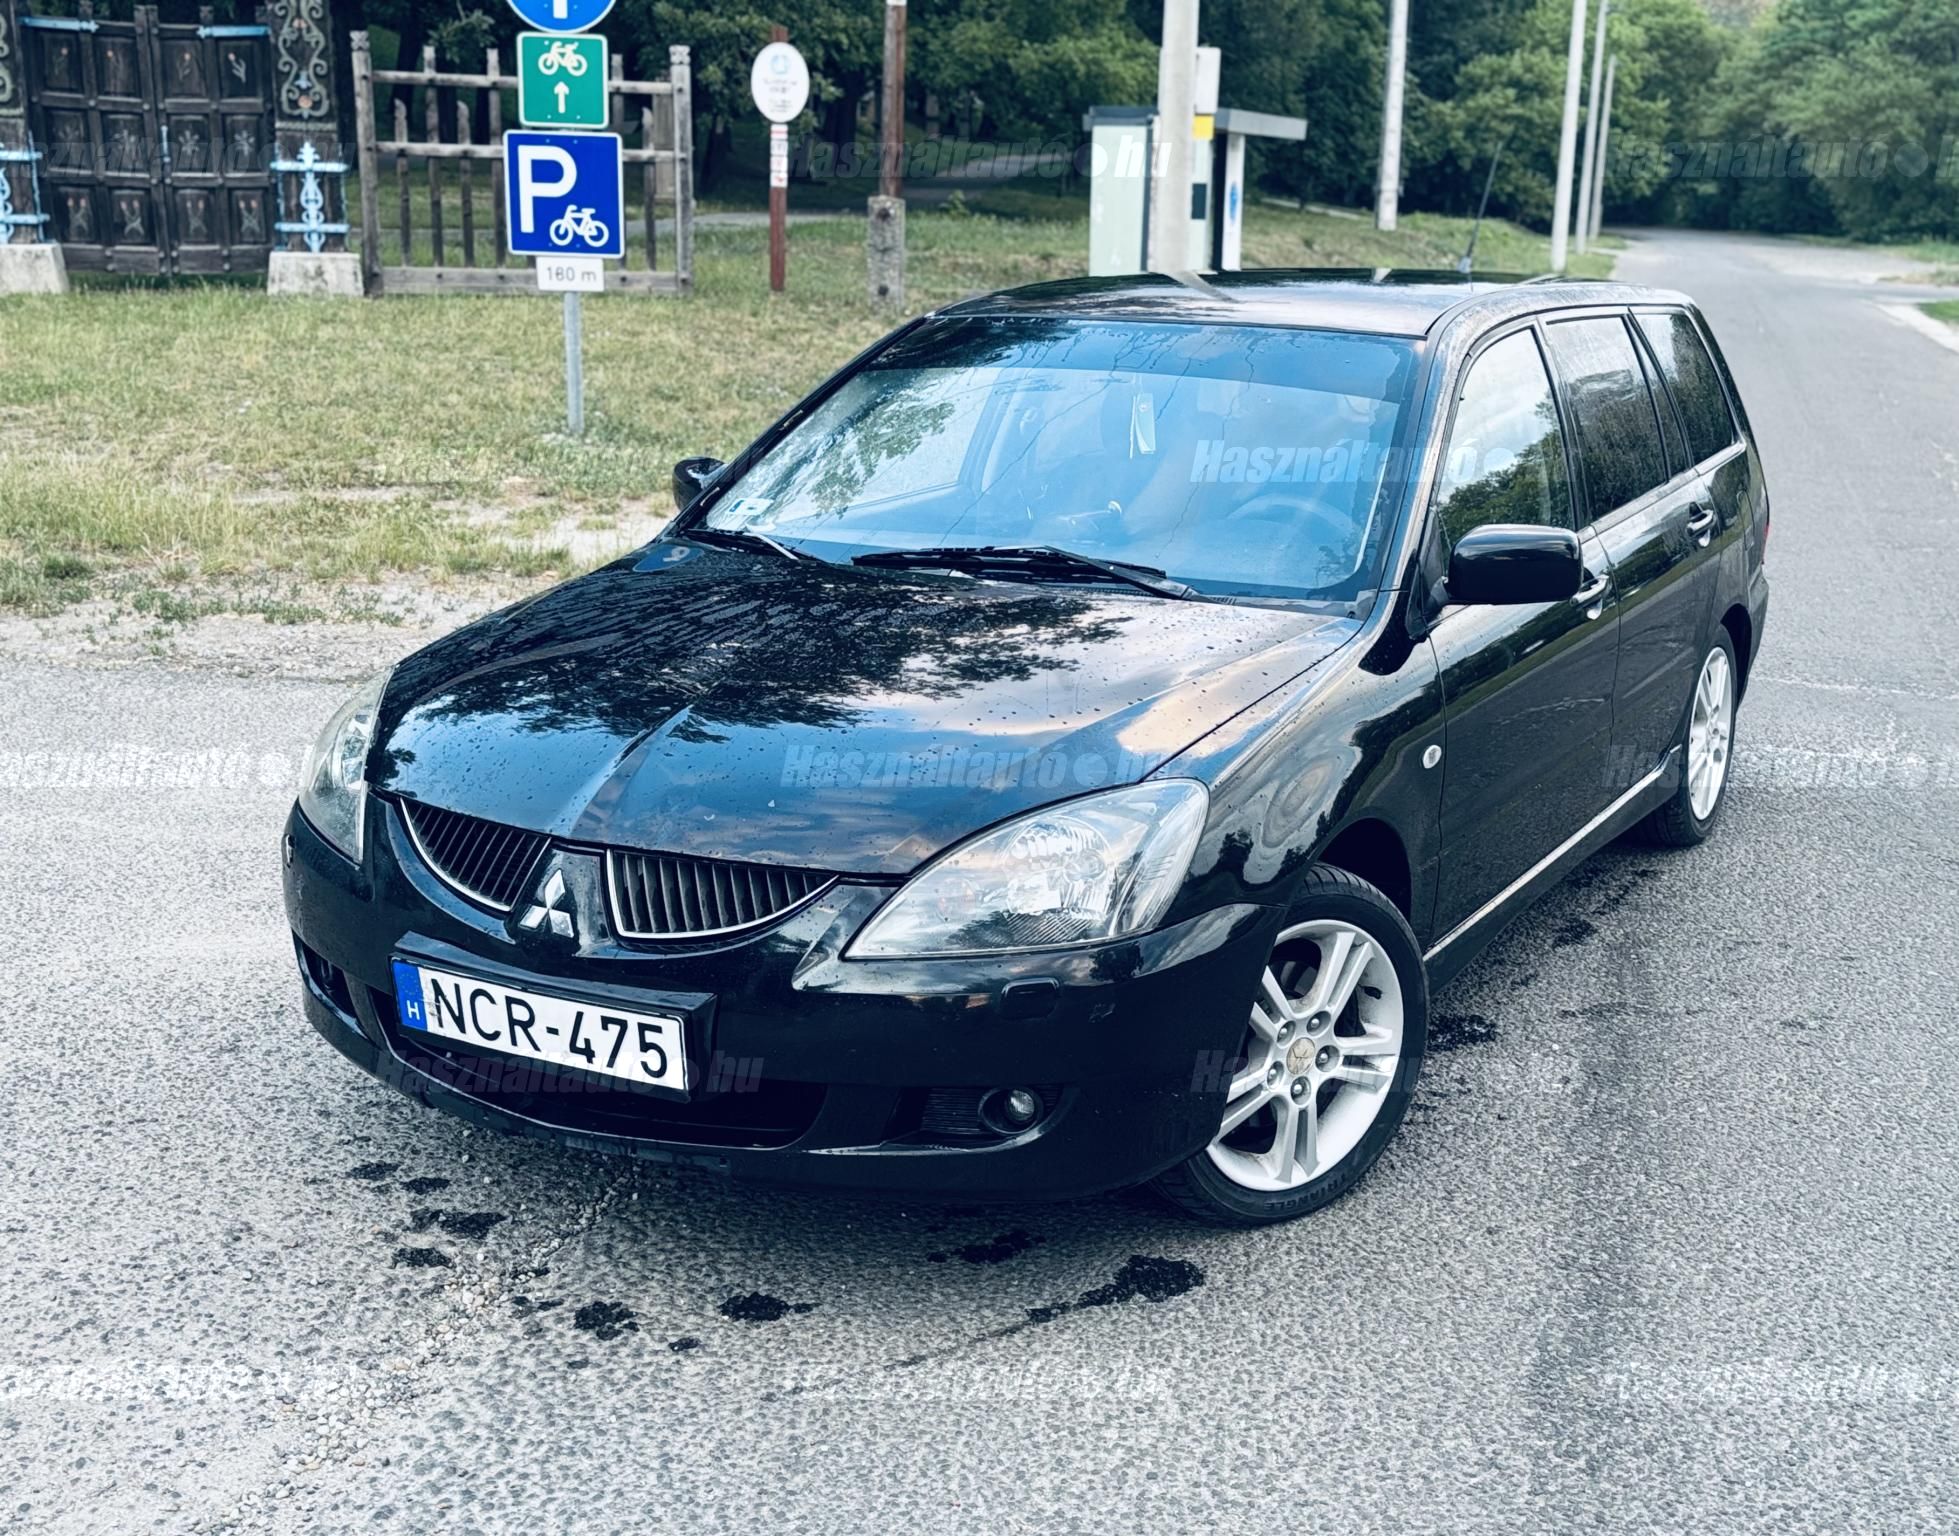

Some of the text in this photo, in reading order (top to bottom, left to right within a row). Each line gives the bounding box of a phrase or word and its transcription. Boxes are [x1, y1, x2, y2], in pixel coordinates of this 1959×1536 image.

[518, 145, 577, 233] P
[580, 271, 597, 283] m
[406, 1000, 420, 1021] H
[431, 978, 668, 1078] NCR-475
[1263, 1172, 1347, 1211] TRIANGLE
